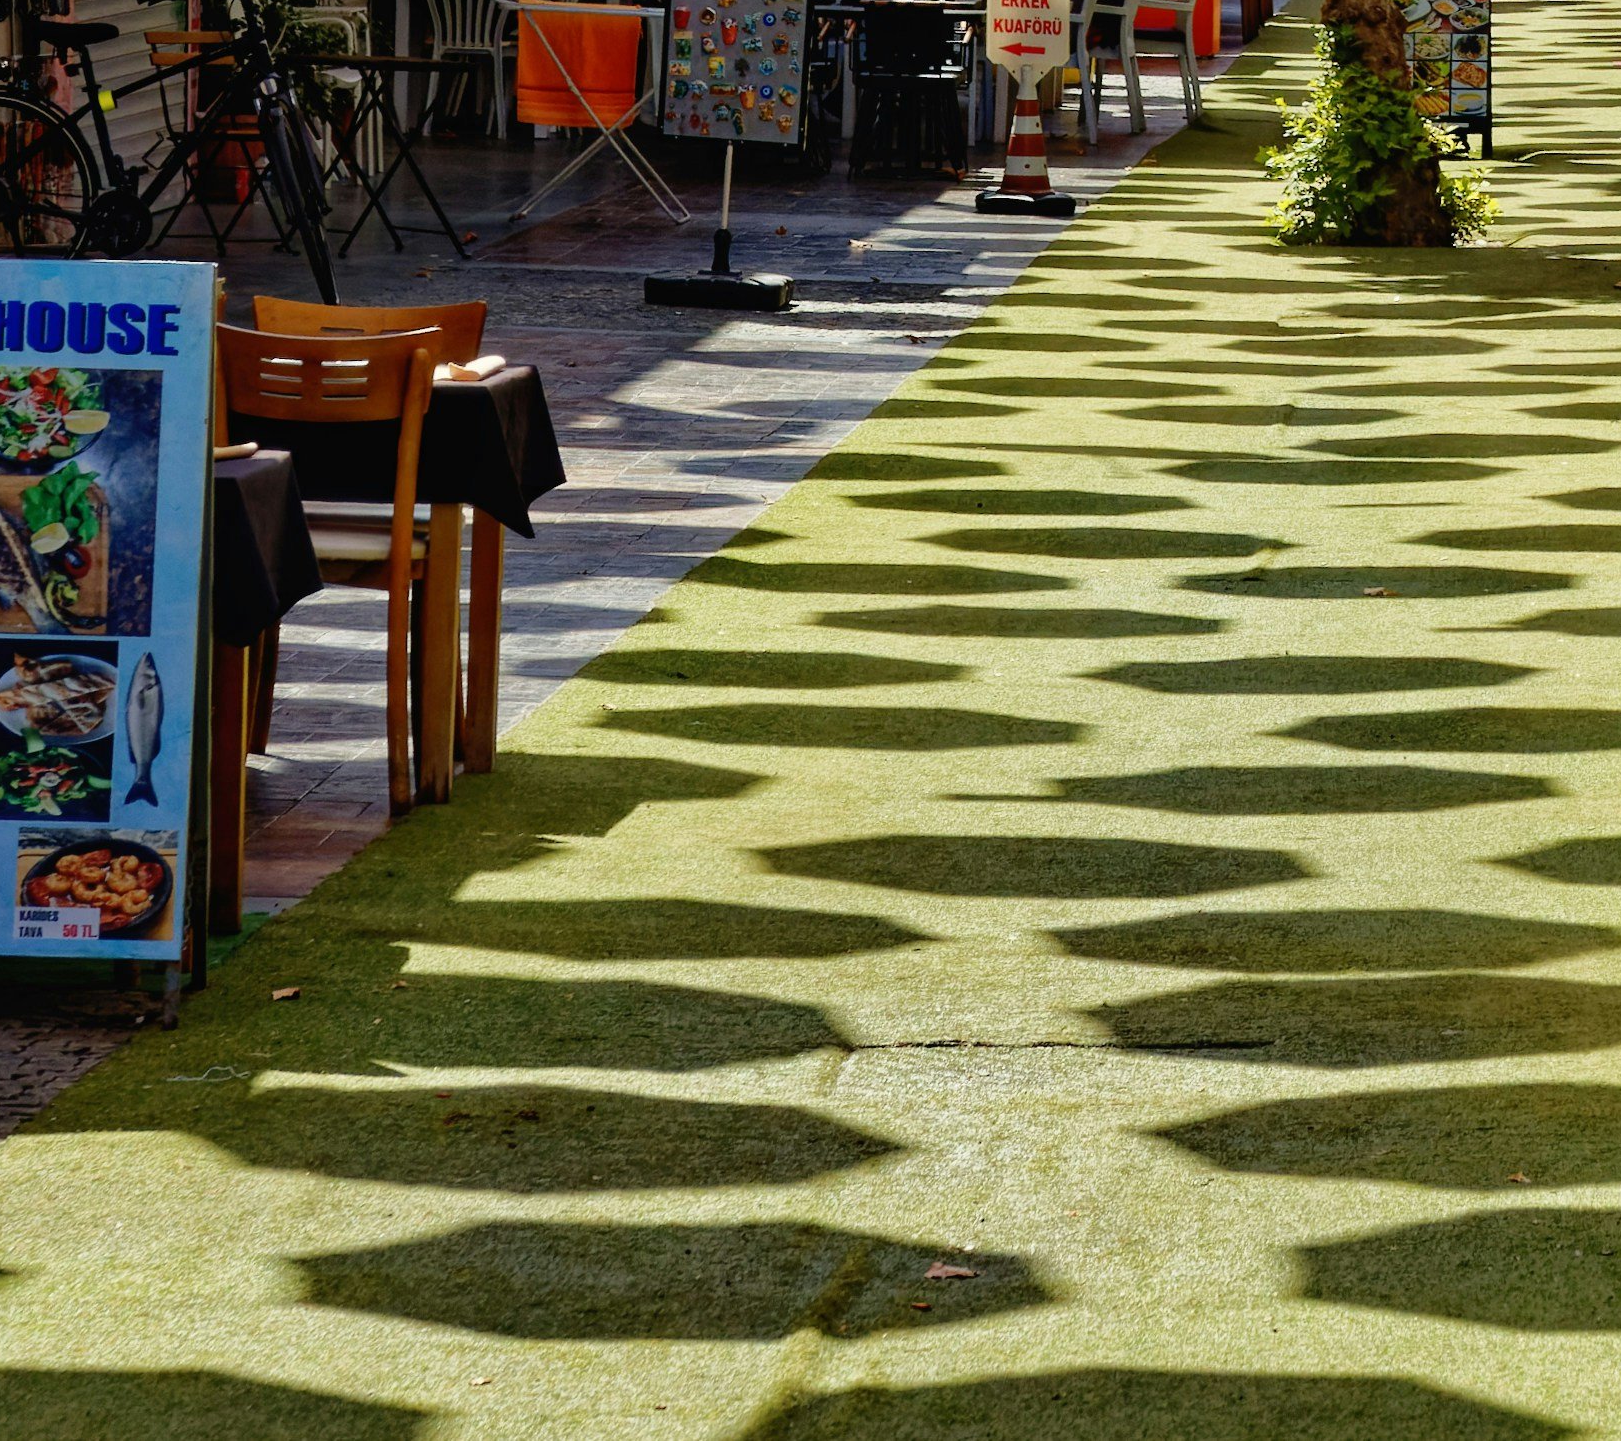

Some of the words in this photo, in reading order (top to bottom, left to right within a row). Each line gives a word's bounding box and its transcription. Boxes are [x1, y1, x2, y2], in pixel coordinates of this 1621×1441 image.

[993, 16, 1063, 36] KUAFÖRÜ
[19, 926, 44, 938] TAVA
[63, 923, 78, 938] 50
